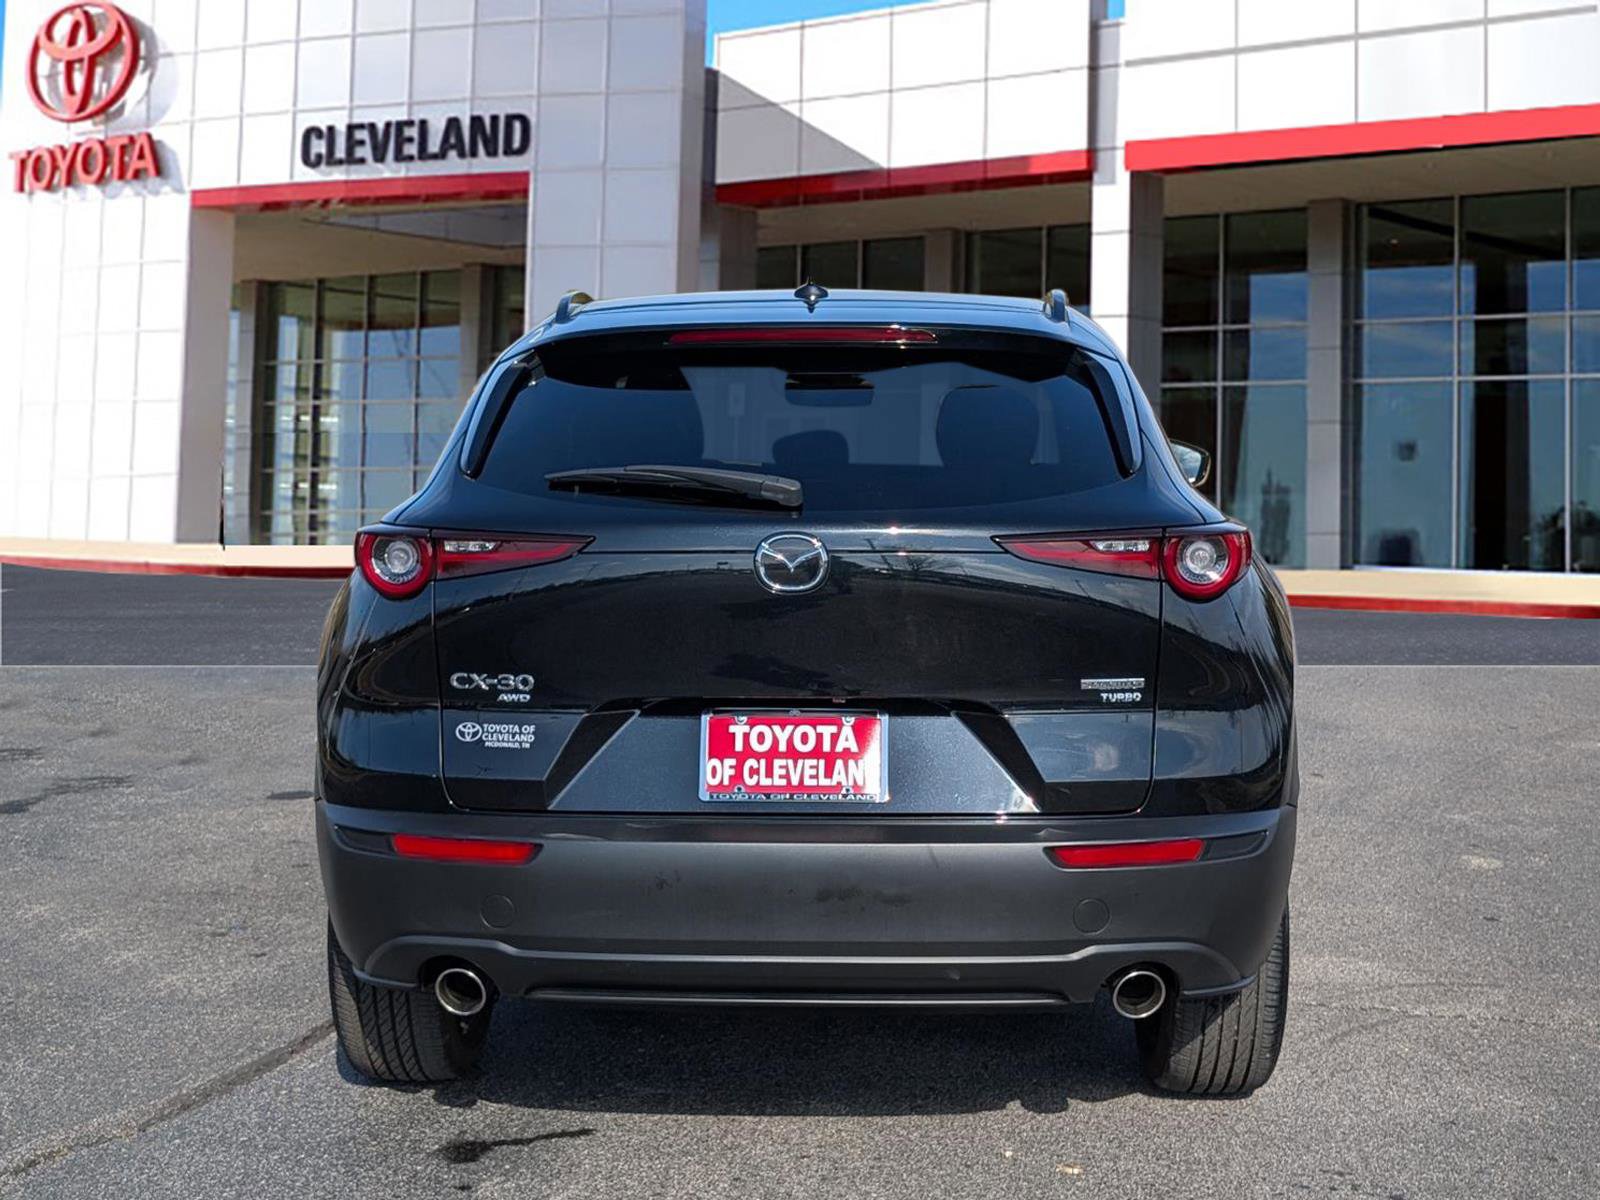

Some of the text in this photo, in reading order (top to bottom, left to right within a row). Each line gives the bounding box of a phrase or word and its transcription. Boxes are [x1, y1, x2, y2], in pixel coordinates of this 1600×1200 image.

[301, 112, 531, 169] CLEVELAND
[10, 131, 160, 194] TOYOTA
[450, 672, 535, 691] CX-30
[497, 693, 531, 702] AWD
[1100, 692, 1142, 702] TURBO
[482, 723, 536, 734] TOYOTA OF
[482, 733, 535, 742] CLEVELAND
[728, 724, 859, 753] TOYOTA
[706, 758, 866, 786] OF CLEVELAN
